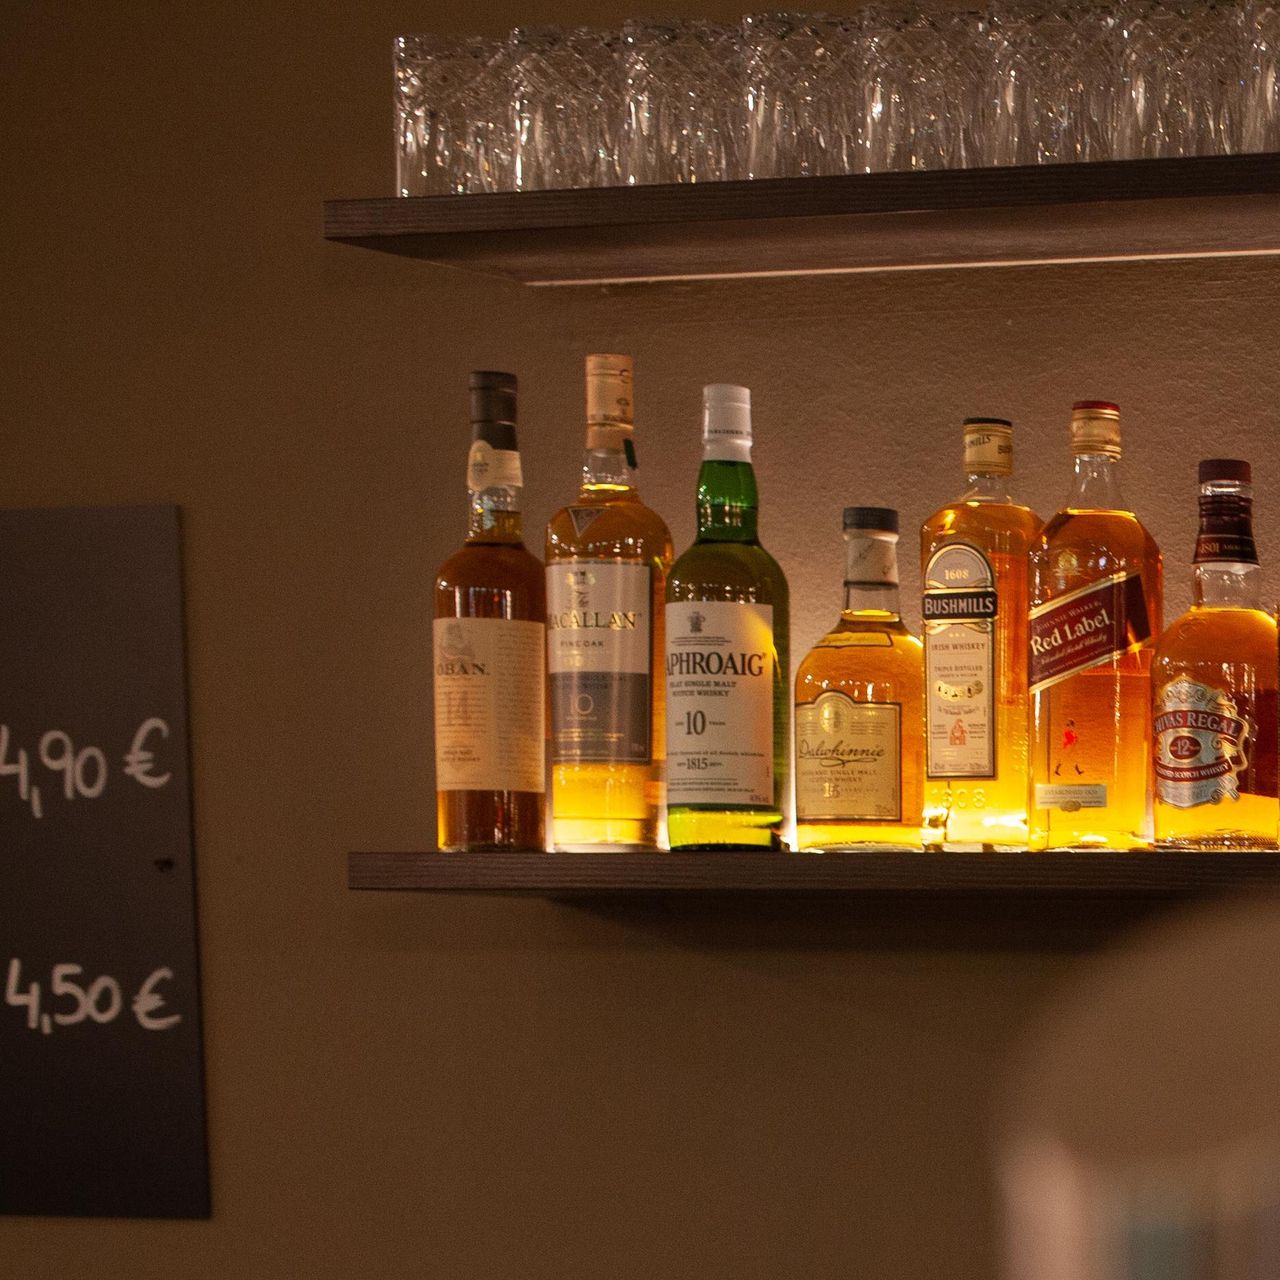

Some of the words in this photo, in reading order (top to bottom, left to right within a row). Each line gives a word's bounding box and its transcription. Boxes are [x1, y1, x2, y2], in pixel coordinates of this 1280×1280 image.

[925, 597, 994, 614] BUSHMILLS
[549, 612, 636, 629] ACALLAN
[1030, 628, 1063, 656] Red
[1064, 608, 1111, 641] Label
[665, 651, 765, 677] APHROAIG
[686, 710, 707, 736] 10
[1156, 711, 1184, 732] HIVAS
[1186, 710, 1239, 737] REGAL
[1175, 739, 1191, 756] 12
[0, 724, 107, 819] 4,90
[124, 717, 172, 788] €
[686, 757, 709, 771] 1815
[5, 957, 123, 1035] 4,50
[132, 966, 182, 1032] €
